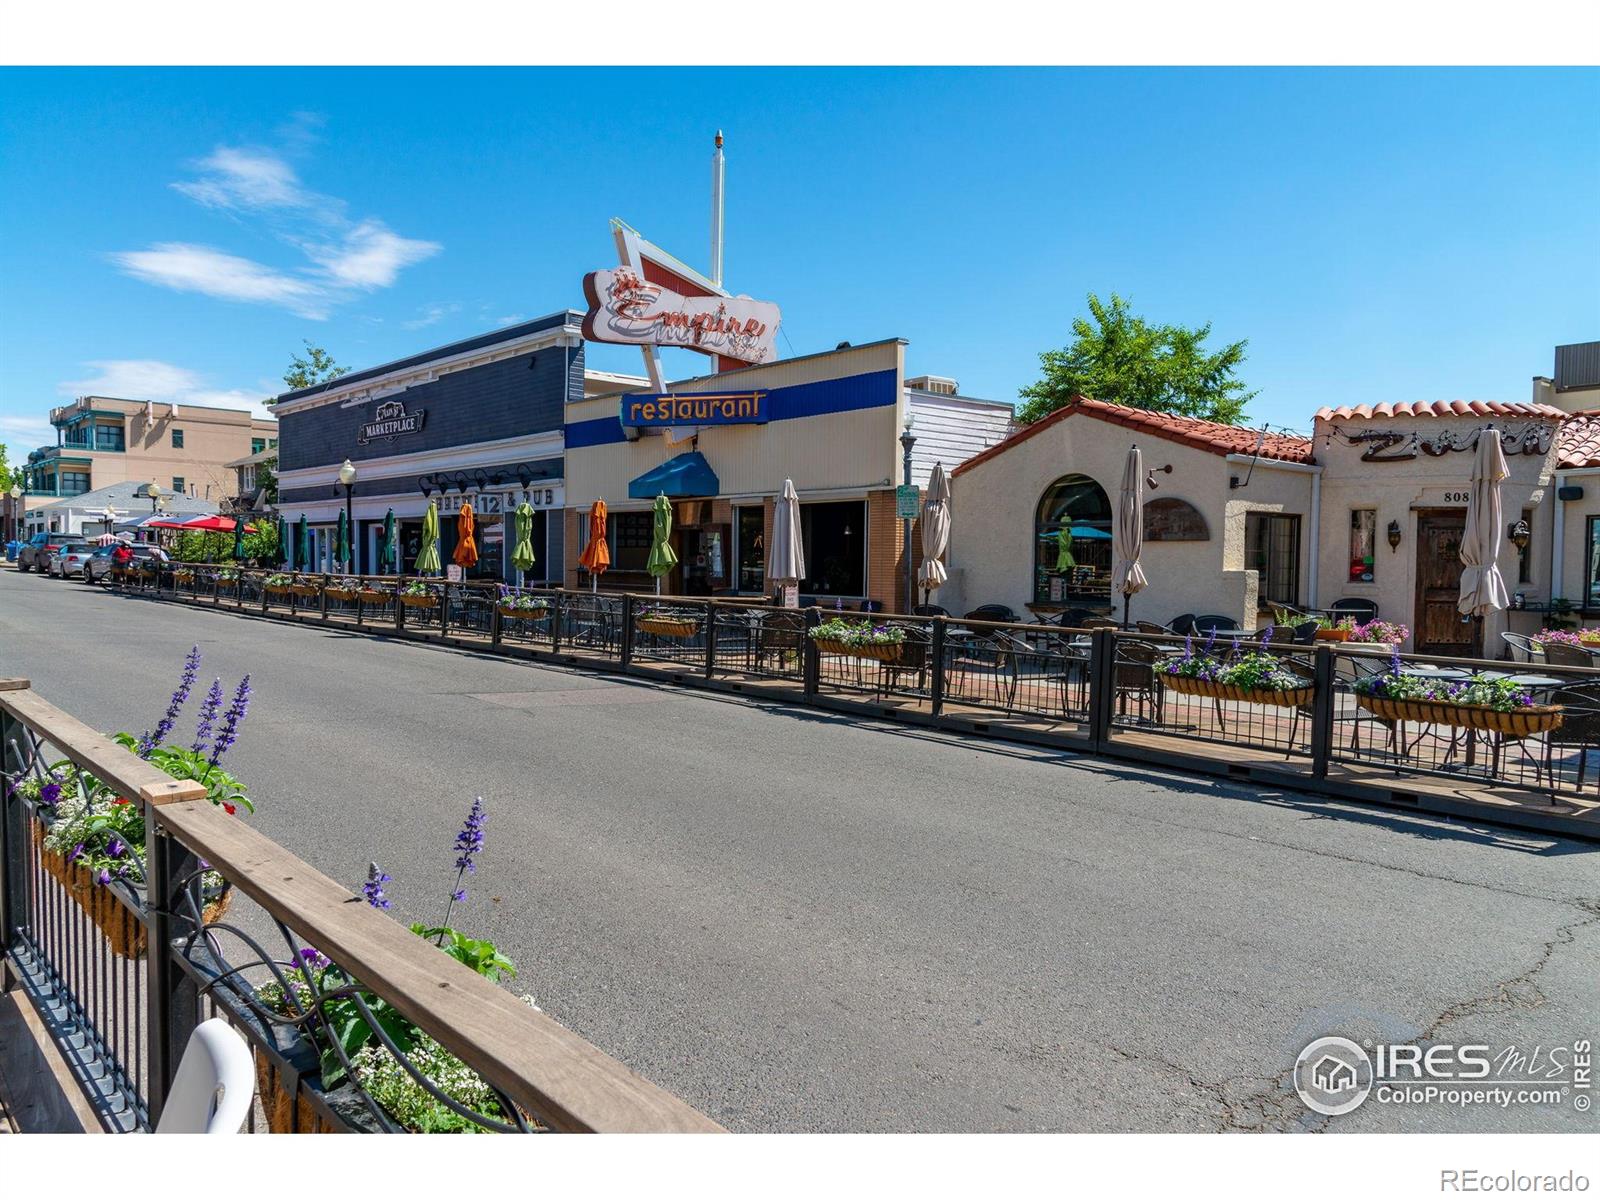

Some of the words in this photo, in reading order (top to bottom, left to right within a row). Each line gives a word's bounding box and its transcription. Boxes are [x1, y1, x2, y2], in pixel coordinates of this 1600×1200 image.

[609, 276, 767, 345] Empire
[630, 391, 767, 421] restaurant
[366, 418, 415, 437] MARKETPLACE
[507, 492, 516, 507] &
[523, 489, 553, 505] PUB
[1444, 492, 1469, 502] 808
